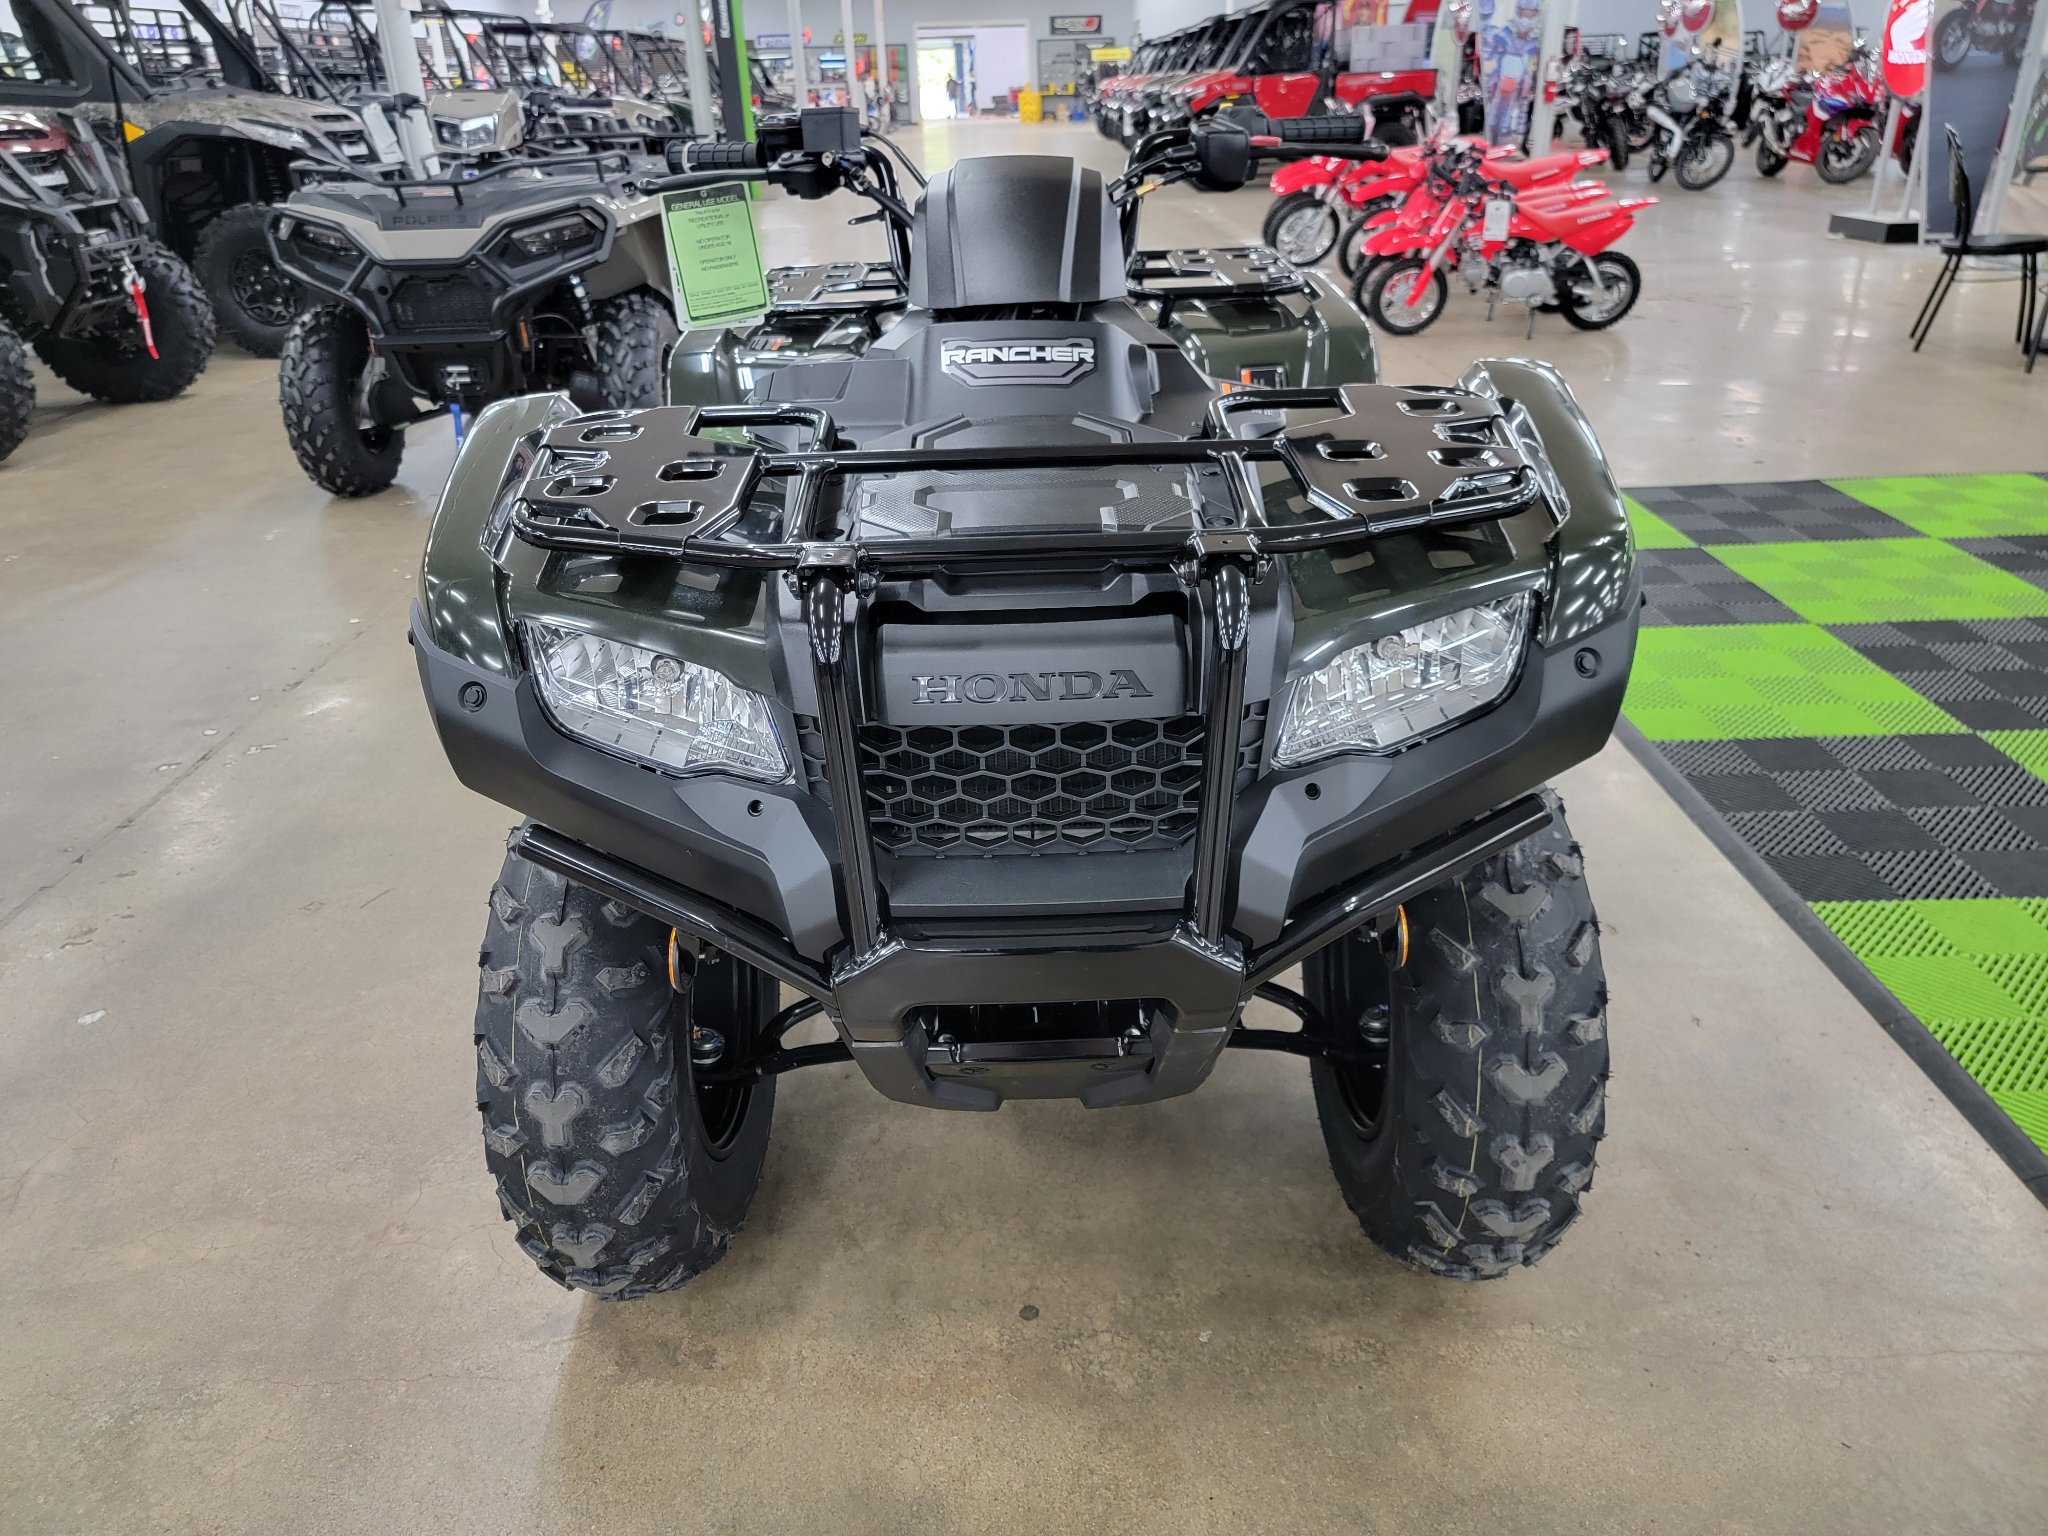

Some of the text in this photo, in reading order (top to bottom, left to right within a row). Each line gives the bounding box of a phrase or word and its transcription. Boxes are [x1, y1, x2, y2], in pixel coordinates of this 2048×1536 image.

[671, 195, 738, 211] GENERAL USE MODEL
[392, 214, 467, 226] POLARS
[945, 346, 1095, 364] RANCHER
[912, 669, 1154, 705] HONDA
